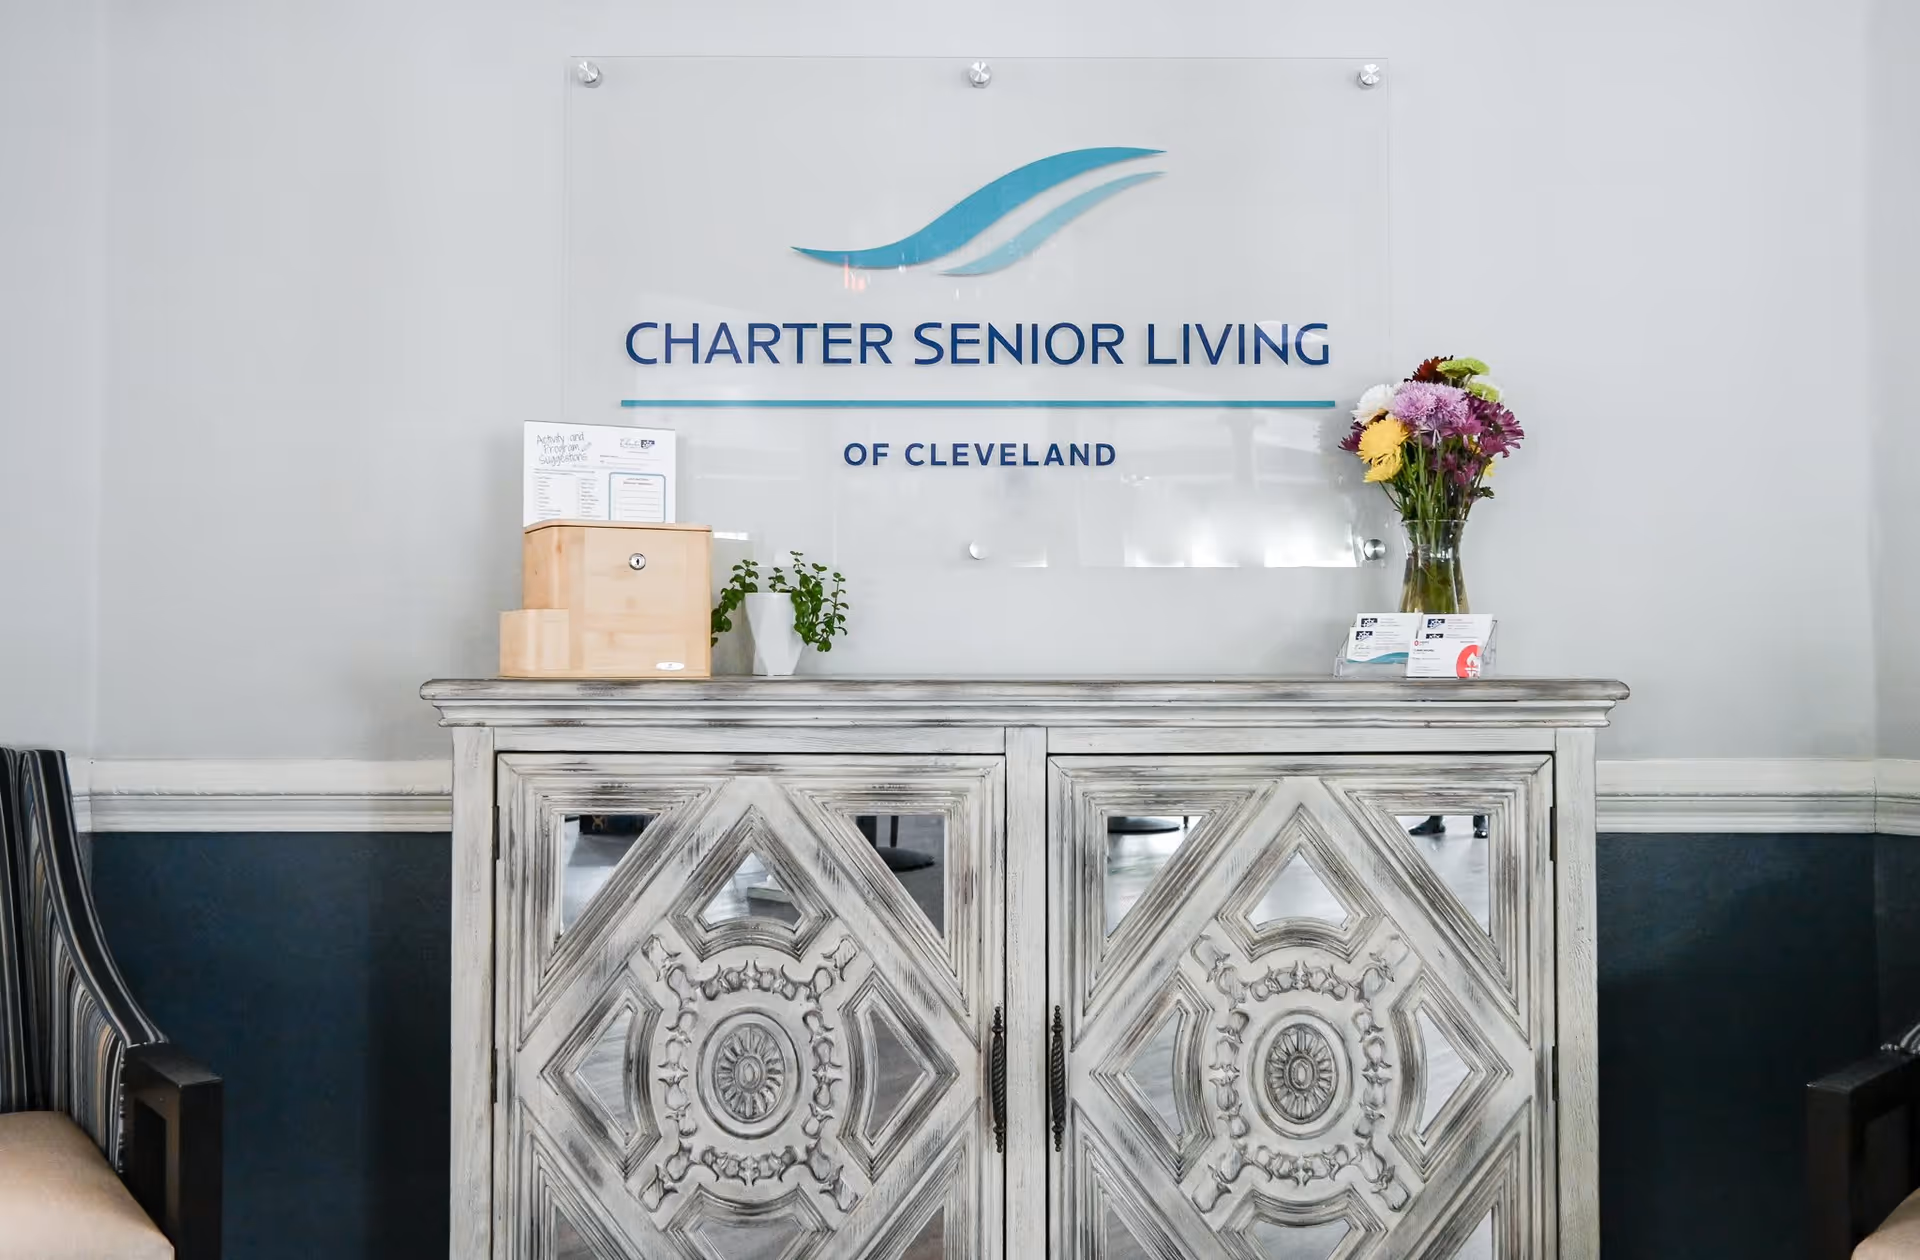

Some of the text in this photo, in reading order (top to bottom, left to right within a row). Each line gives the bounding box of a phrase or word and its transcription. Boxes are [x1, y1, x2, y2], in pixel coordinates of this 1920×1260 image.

[625, 322, 1329, 365] CHARTER SENIOR LIVING
[569, 432, 585, 441] and
[844, 443, 1115, 466] OF CLEVELAND
